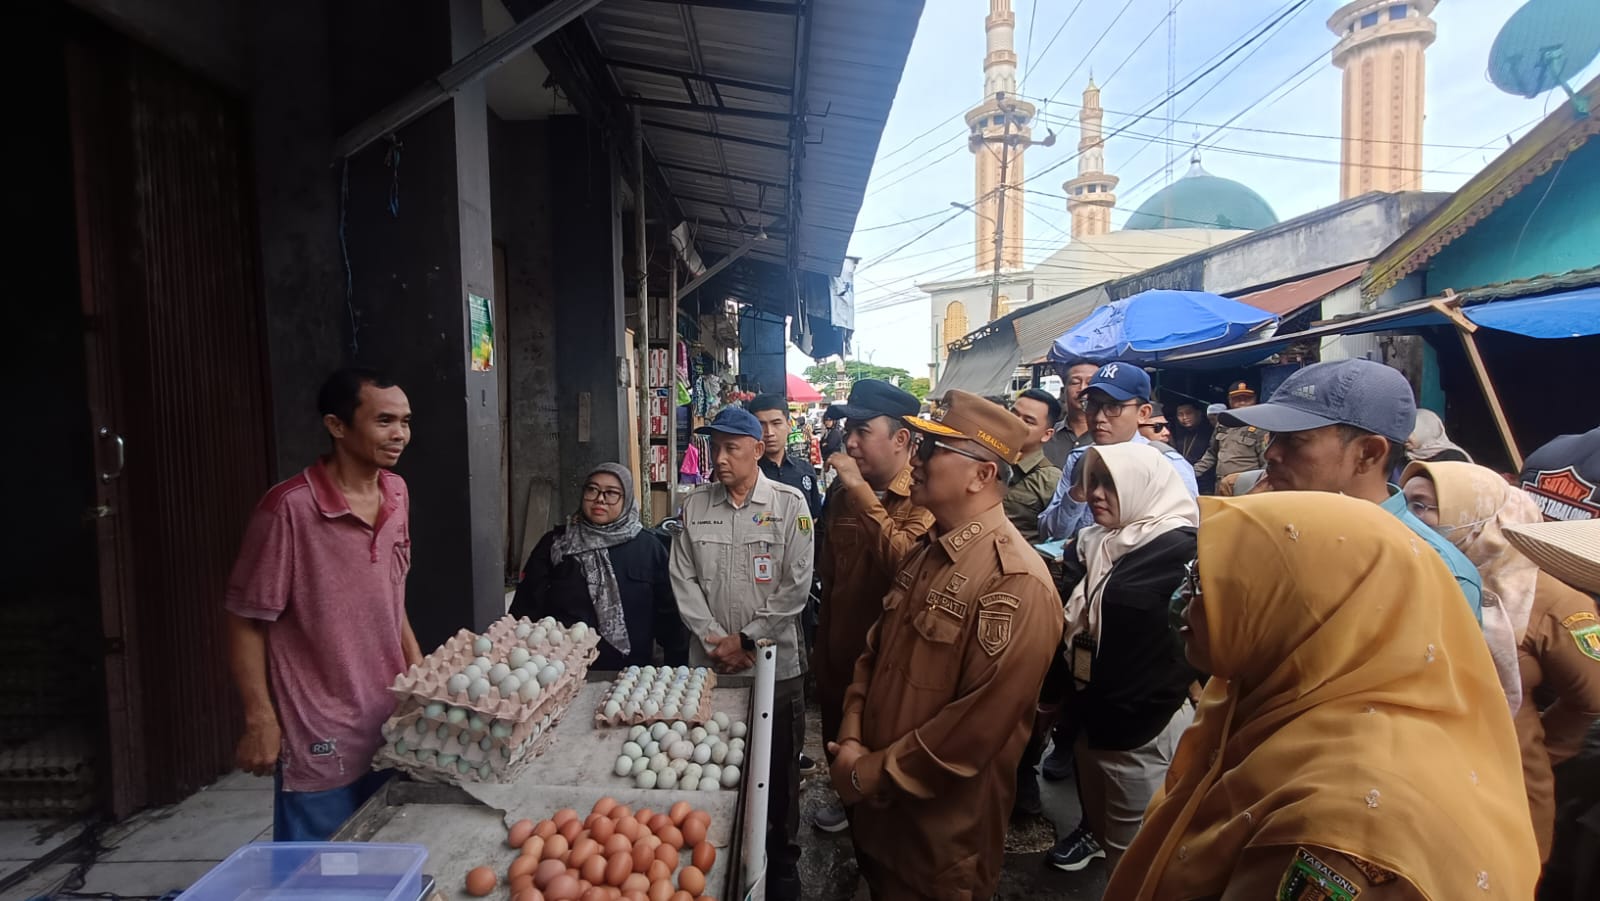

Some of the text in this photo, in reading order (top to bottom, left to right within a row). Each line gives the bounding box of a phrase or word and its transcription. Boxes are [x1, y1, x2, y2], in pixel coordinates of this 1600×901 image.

[1100, 363, 1118, 379] NY
[977, 430, 1010, 455] TABALONG
[1542, 478, 1581, 499] SATUAN
[1302, 851, 1357, 895] TABALONG
